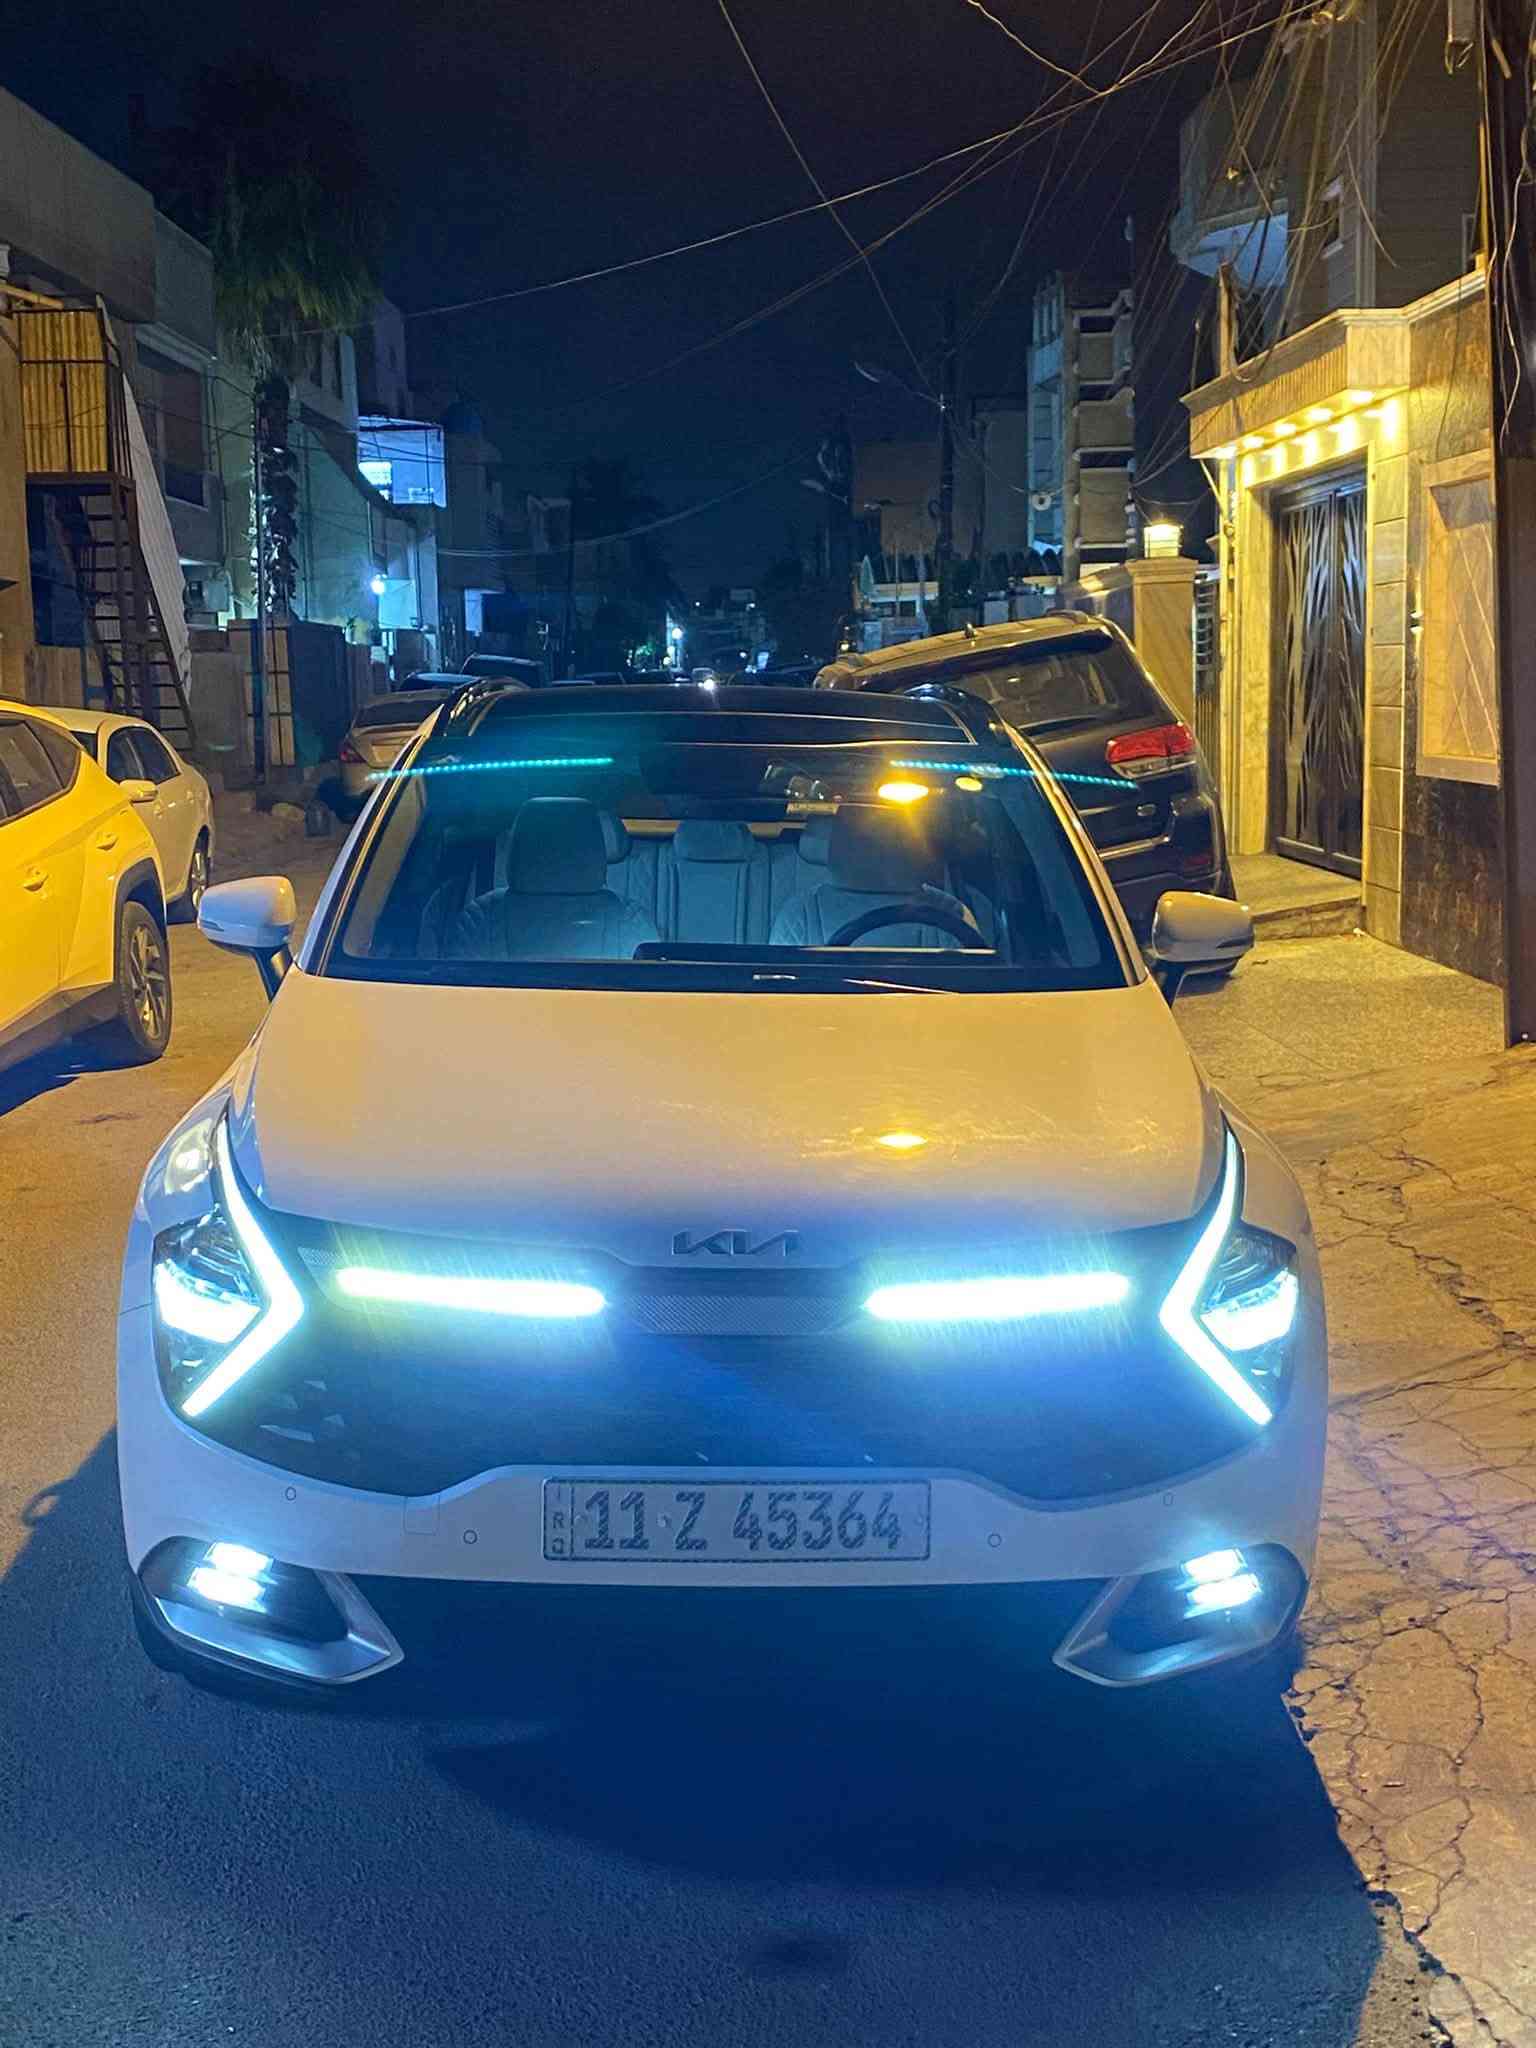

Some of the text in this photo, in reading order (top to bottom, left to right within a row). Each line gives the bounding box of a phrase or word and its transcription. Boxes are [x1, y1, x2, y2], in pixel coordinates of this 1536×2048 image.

[671, 1228, 799, 1256] KIA
[584, 1490, 902, 1551] 11 Z 45364
